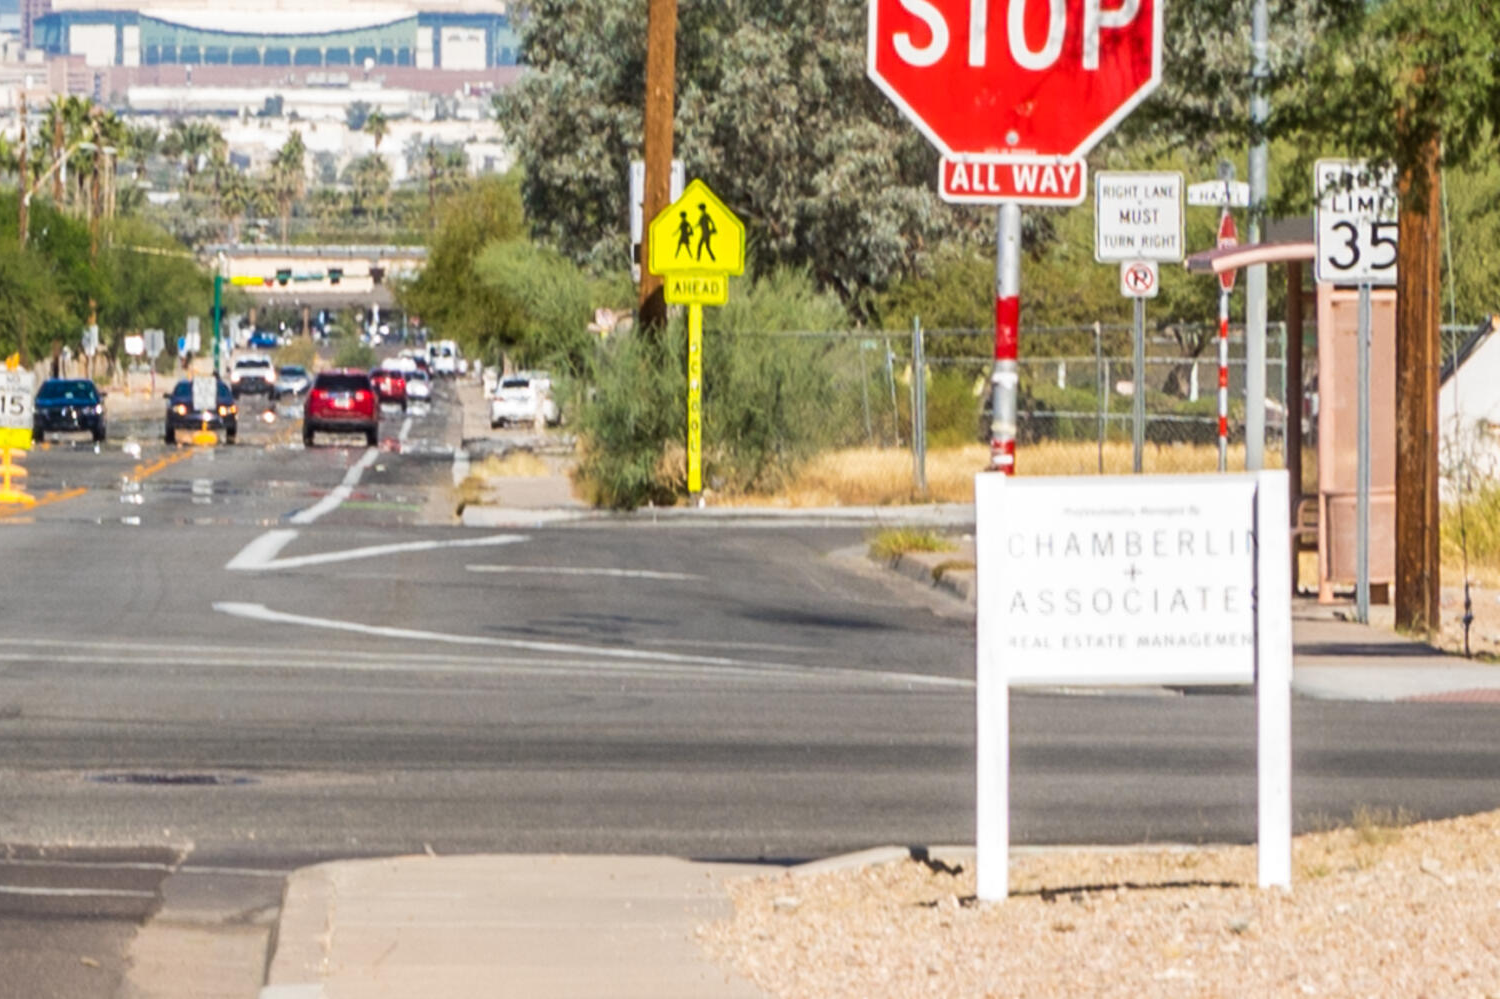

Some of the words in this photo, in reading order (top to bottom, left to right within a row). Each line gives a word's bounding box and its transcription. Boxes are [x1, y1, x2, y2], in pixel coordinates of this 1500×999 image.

[950, 162, 1001, 192] ALL
[1011, 164, 1077, 194] WAY
[1102, 184, 1138, 199] RIGHT
[1144, 184, 1175, 199] LANE
[1119, 207, 1159, 225] MUST
[1103, 234, 1135, 249] TURN
[1141, 234, 1176, 249] RIGHT
[1328, 220, 1398, 270] 35
[673, 280, 720, 295] AHEAD
[1, 394, 25, 415] 15
[1061, 633, 1128, 649] ESTATE
[1135, 631, 1257, 649] MANAGEMEN
